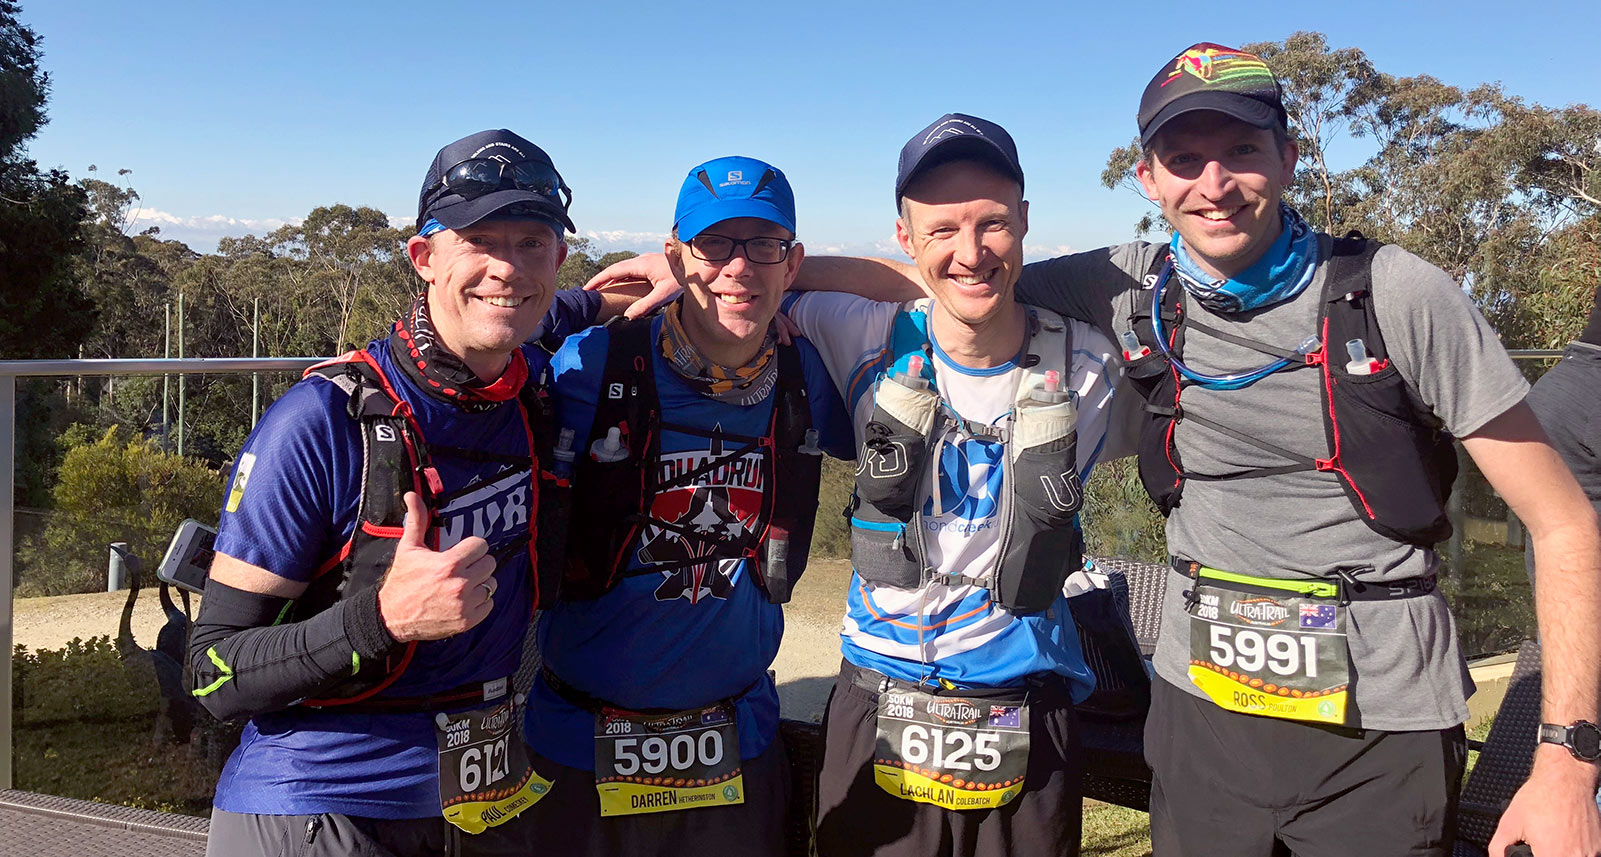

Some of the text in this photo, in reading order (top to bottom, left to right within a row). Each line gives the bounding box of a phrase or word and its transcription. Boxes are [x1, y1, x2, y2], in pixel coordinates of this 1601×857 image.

[1197, 604, 1219, 620] 2018
[1209, 624, 1318, 678] 5991
[887, 695, 914, 706] 50KM
[1233, 691, 1298, 713] ROSS POULTON
[887, 704, 915, 719] 2018
[605, 722, 632, 734] 2018
[446, 729, 471, 748] 2018
[901, 724, 1002, 772] 6125
[613, 729, 724, 776] 5900
[631, 790, 677, 809] DARREN
[900, 783, 991, 806] LACHLAN COLEBATCH
[480, 805, 506, 824] PAUL
